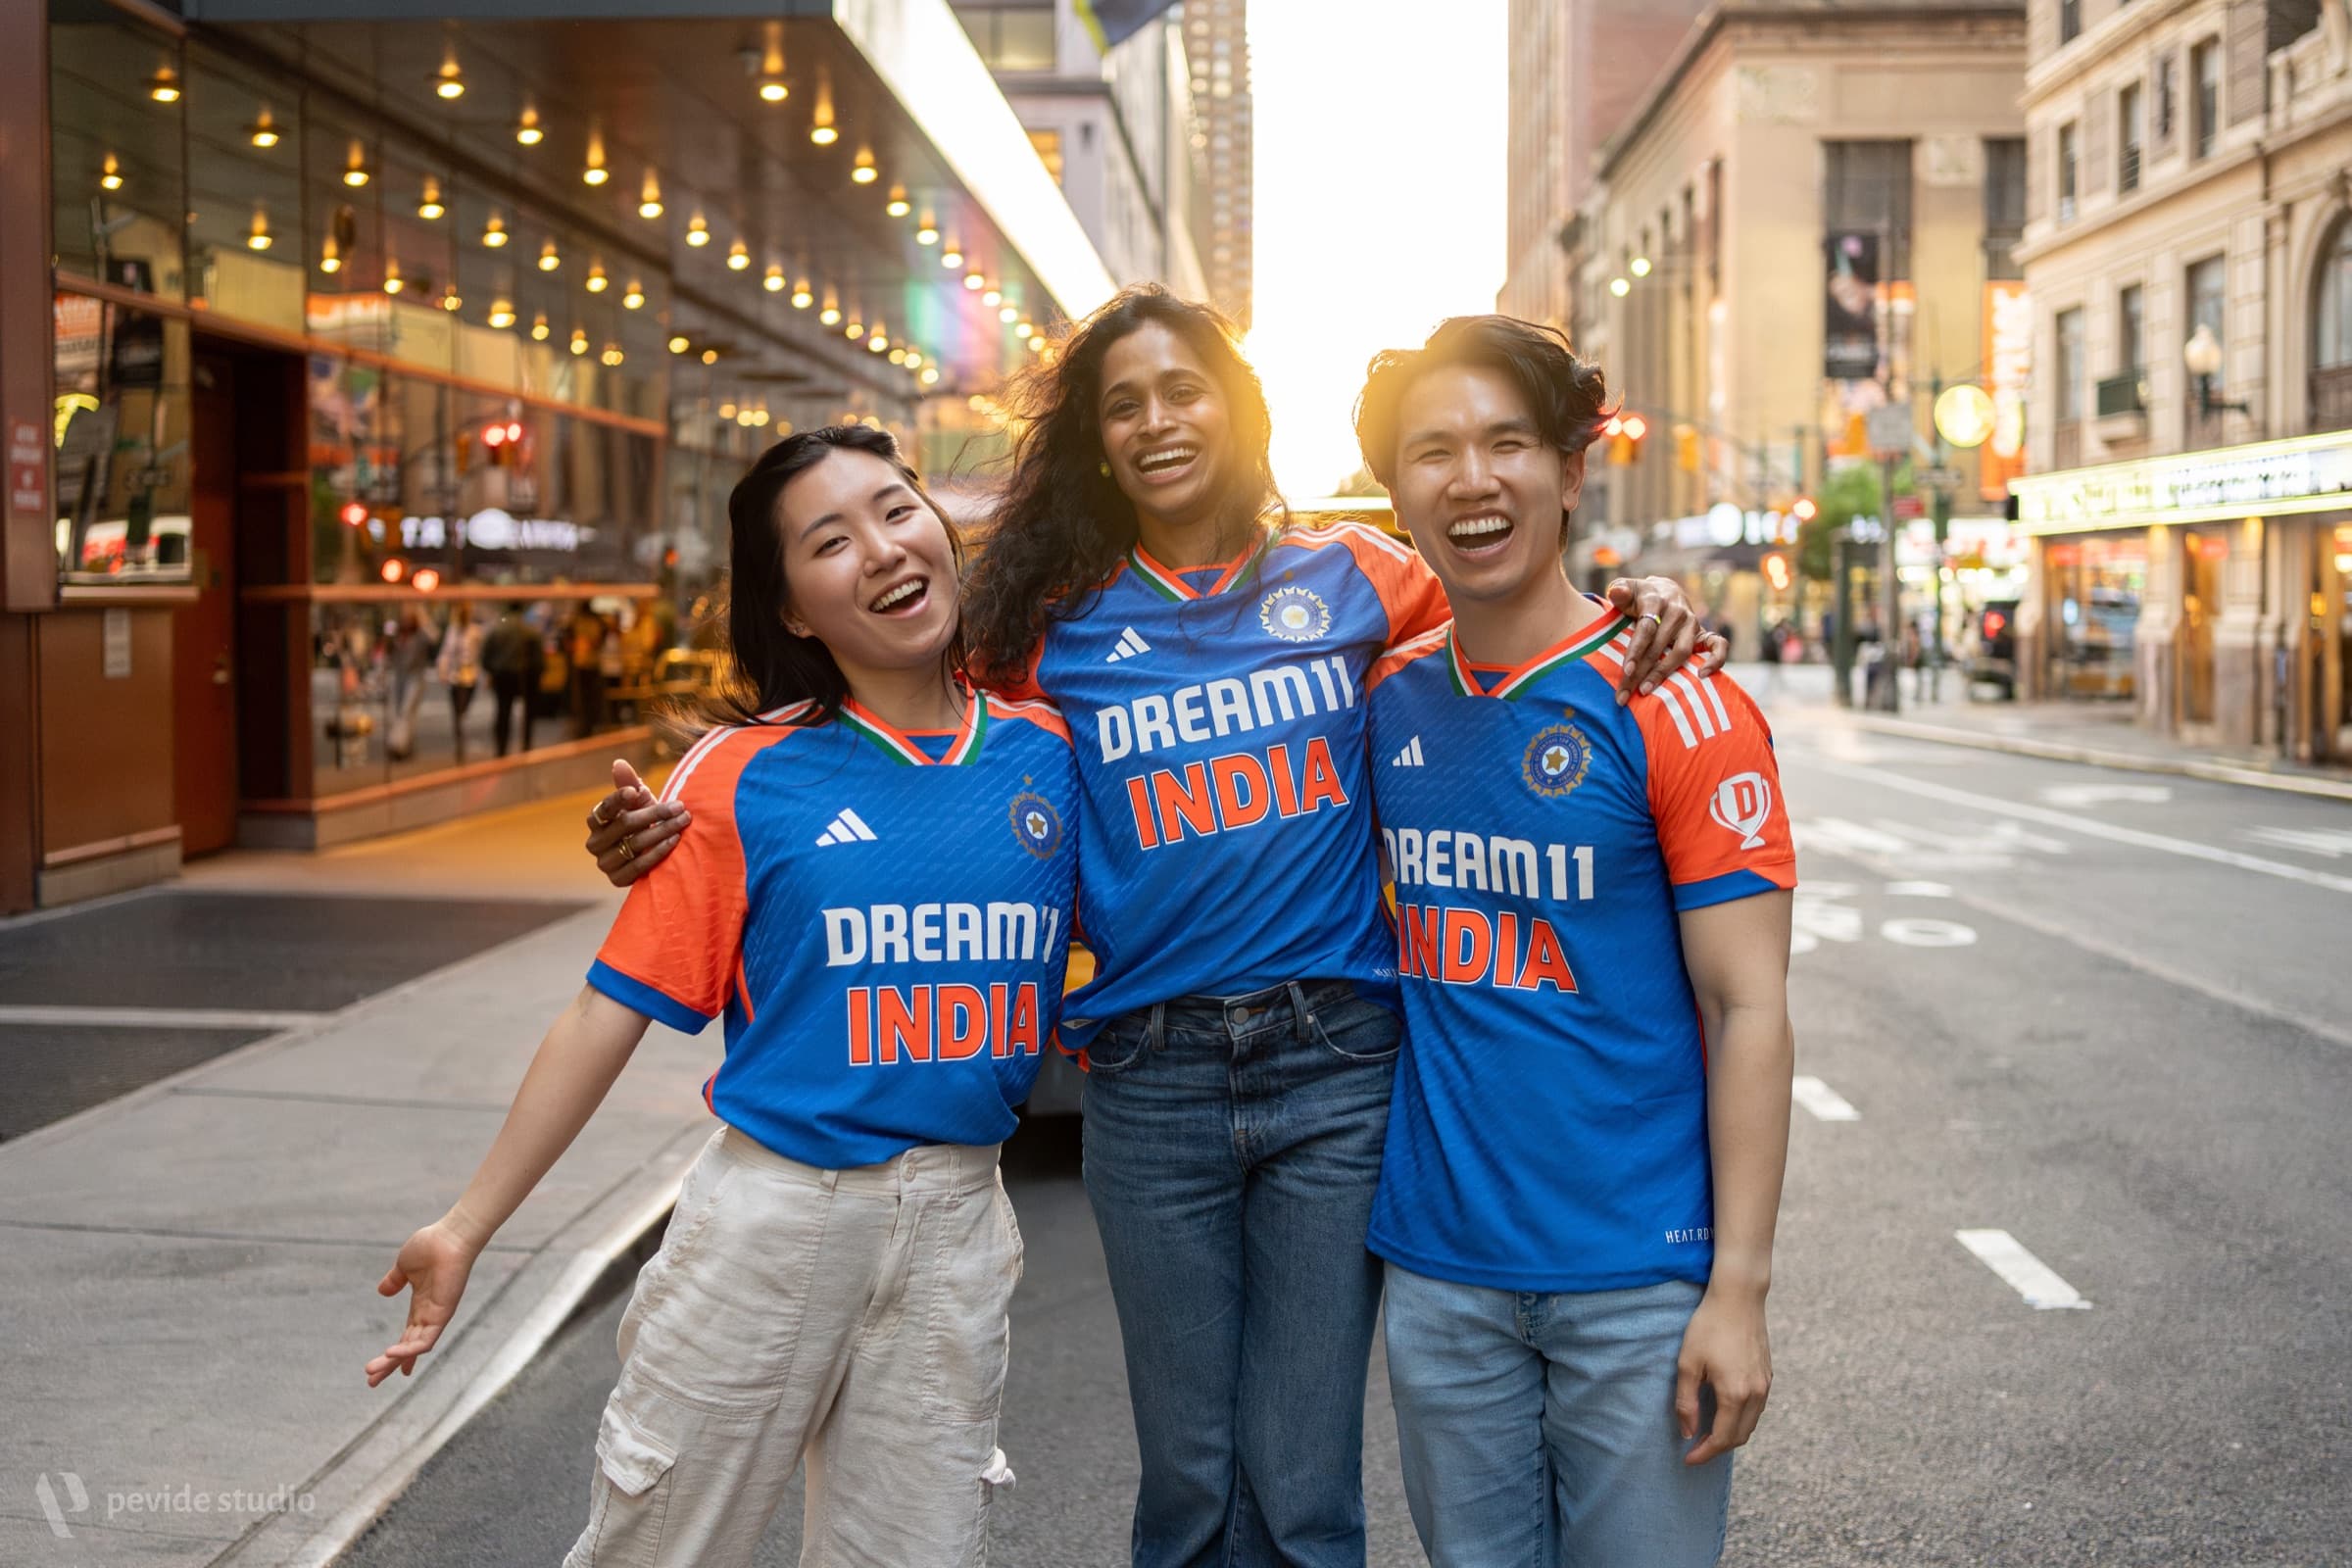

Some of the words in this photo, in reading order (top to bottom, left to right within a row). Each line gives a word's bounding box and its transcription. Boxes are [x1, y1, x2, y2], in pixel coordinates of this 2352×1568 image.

[1096, 656, 1354, 763] DREAM11
[1126, 736, 1349, 851] INDIA
[1731, 780, 1758, 822] D
[1396, 902, 1579, 994] INDIA
[847, 982, 1039, 1066] INDIA
